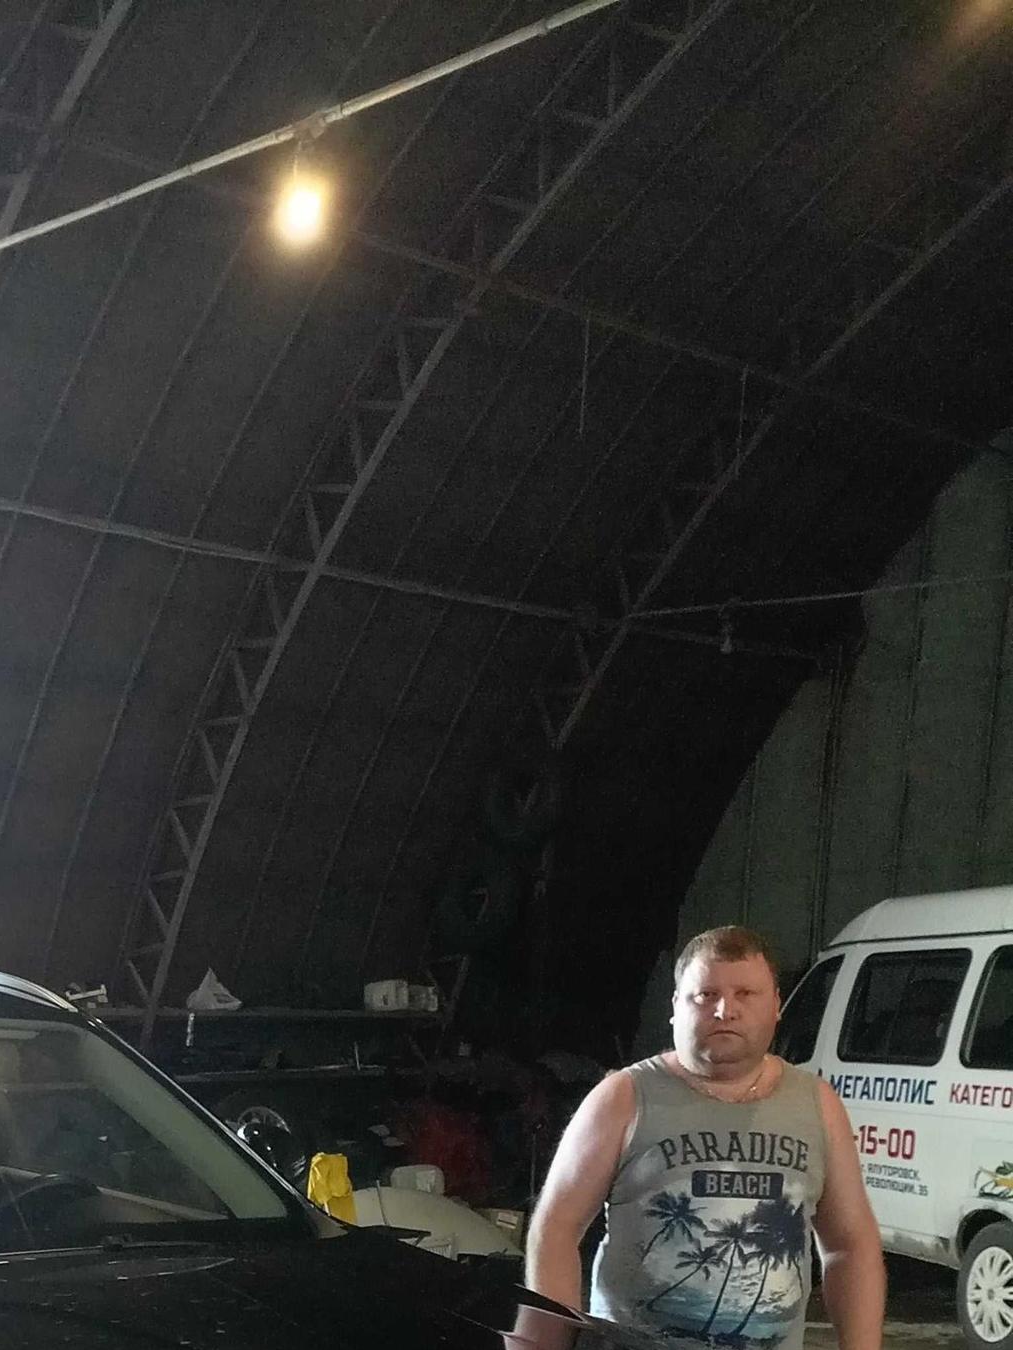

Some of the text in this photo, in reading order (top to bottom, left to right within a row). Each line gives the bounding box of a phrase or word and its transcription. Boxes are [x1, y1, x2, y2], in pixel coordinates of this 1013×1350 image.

[830, 1074, 1013, 1108] МЕГАПОЛИС КАТЕГО
[657, 1131, 809, 1172] PARADISE
[706, 1173, 771, 1196] BEACH
